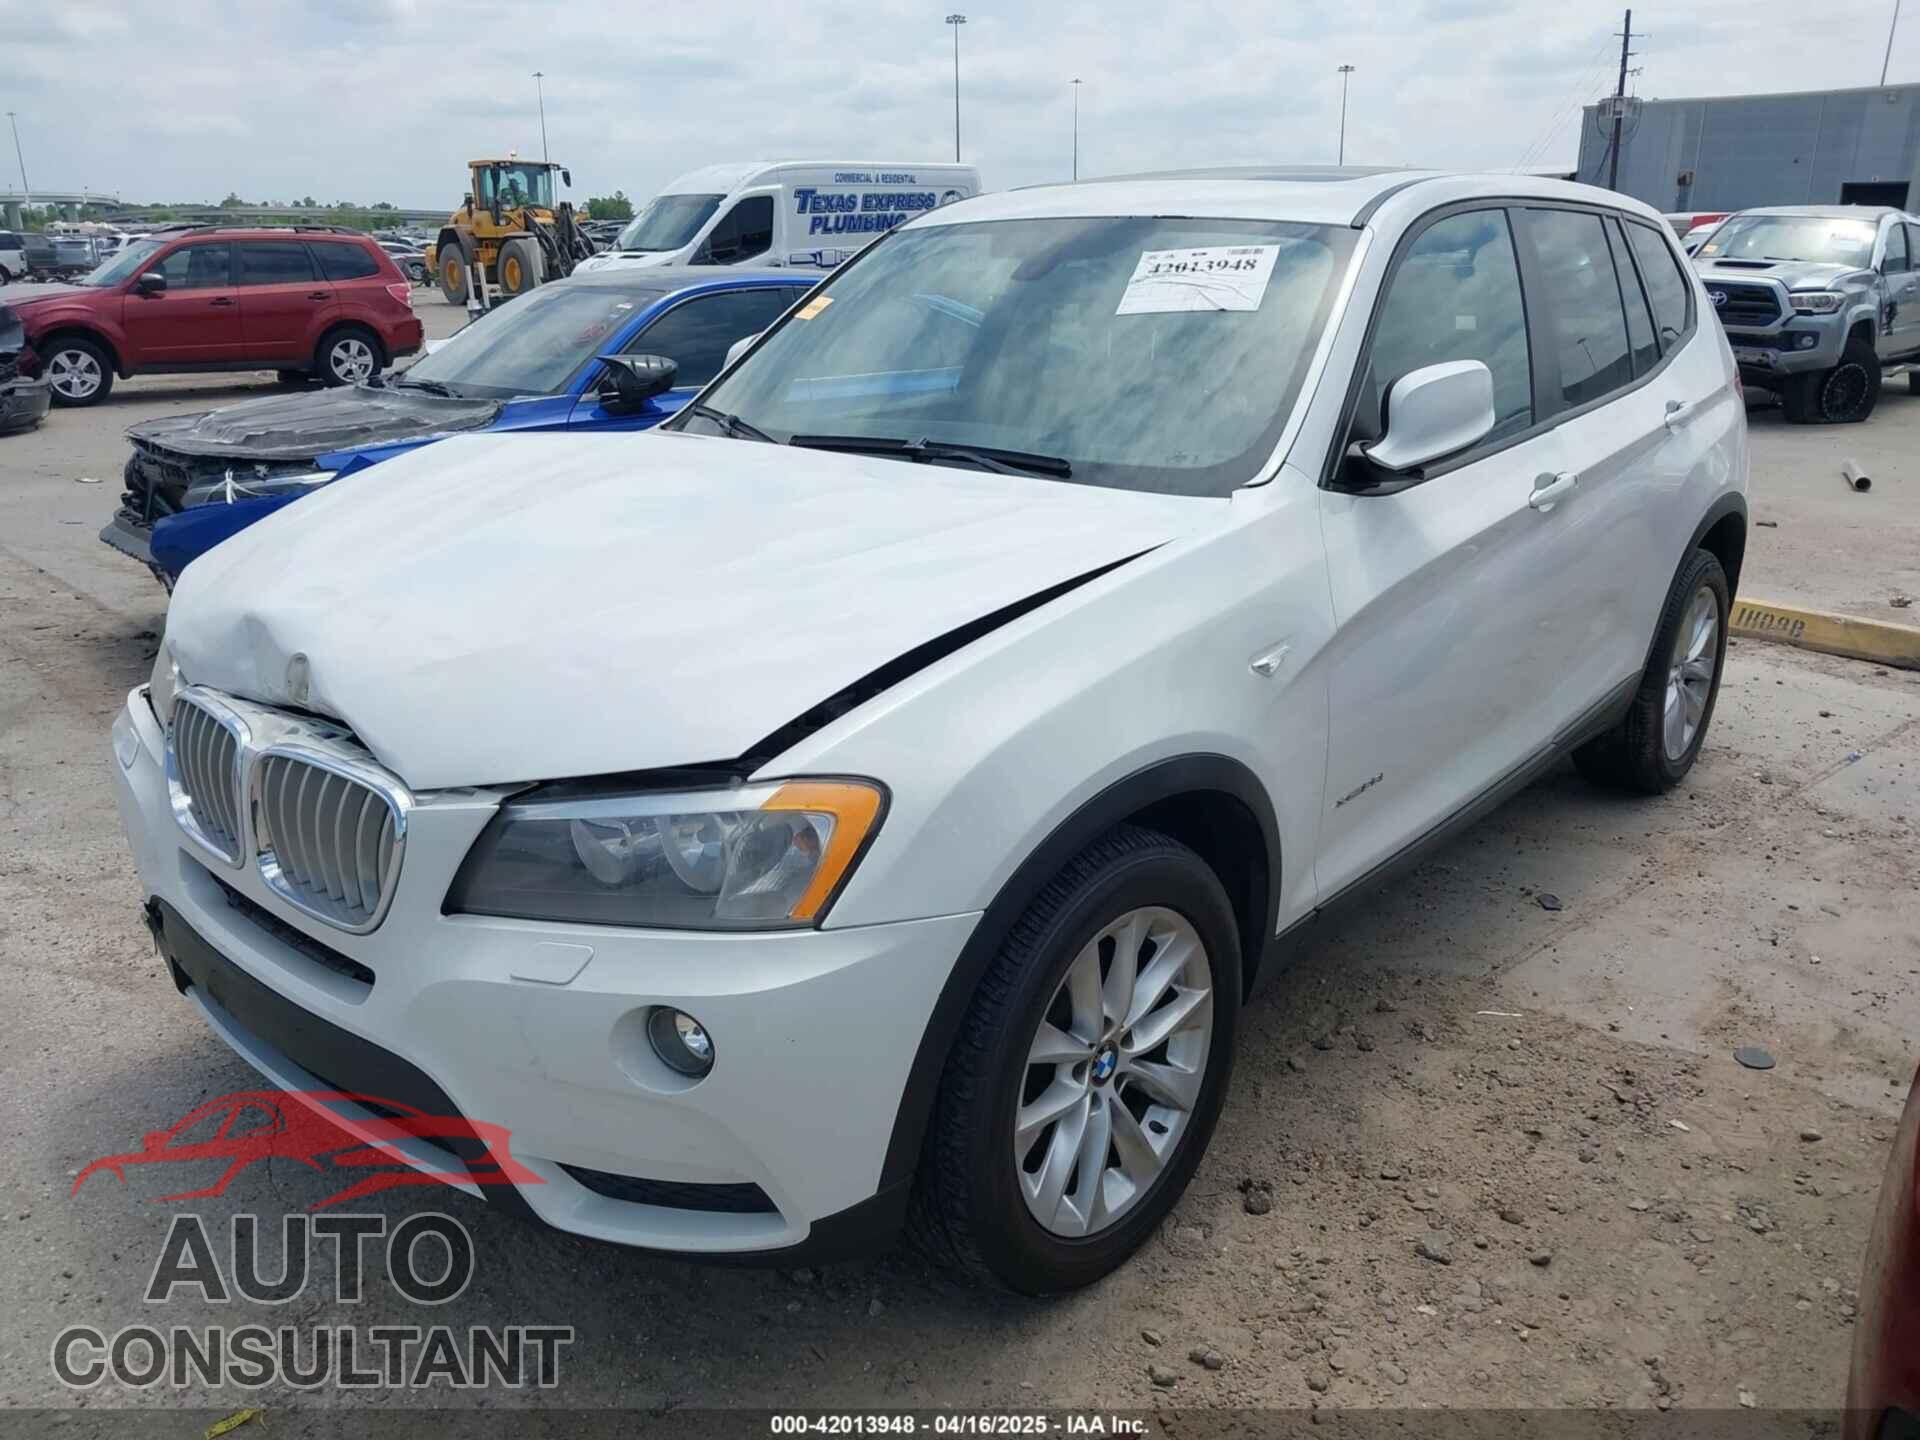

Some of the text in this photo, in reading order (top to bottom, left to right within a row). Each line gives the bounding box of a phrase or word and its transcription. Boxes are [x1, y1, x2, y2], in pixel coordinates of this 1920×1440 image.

[835, 173, 872, 184] COMMERCIAL
[881, 174, 916, 184] RESIDENTIAL
[794, 188, 936, 213] TEXAS EXPRESS
